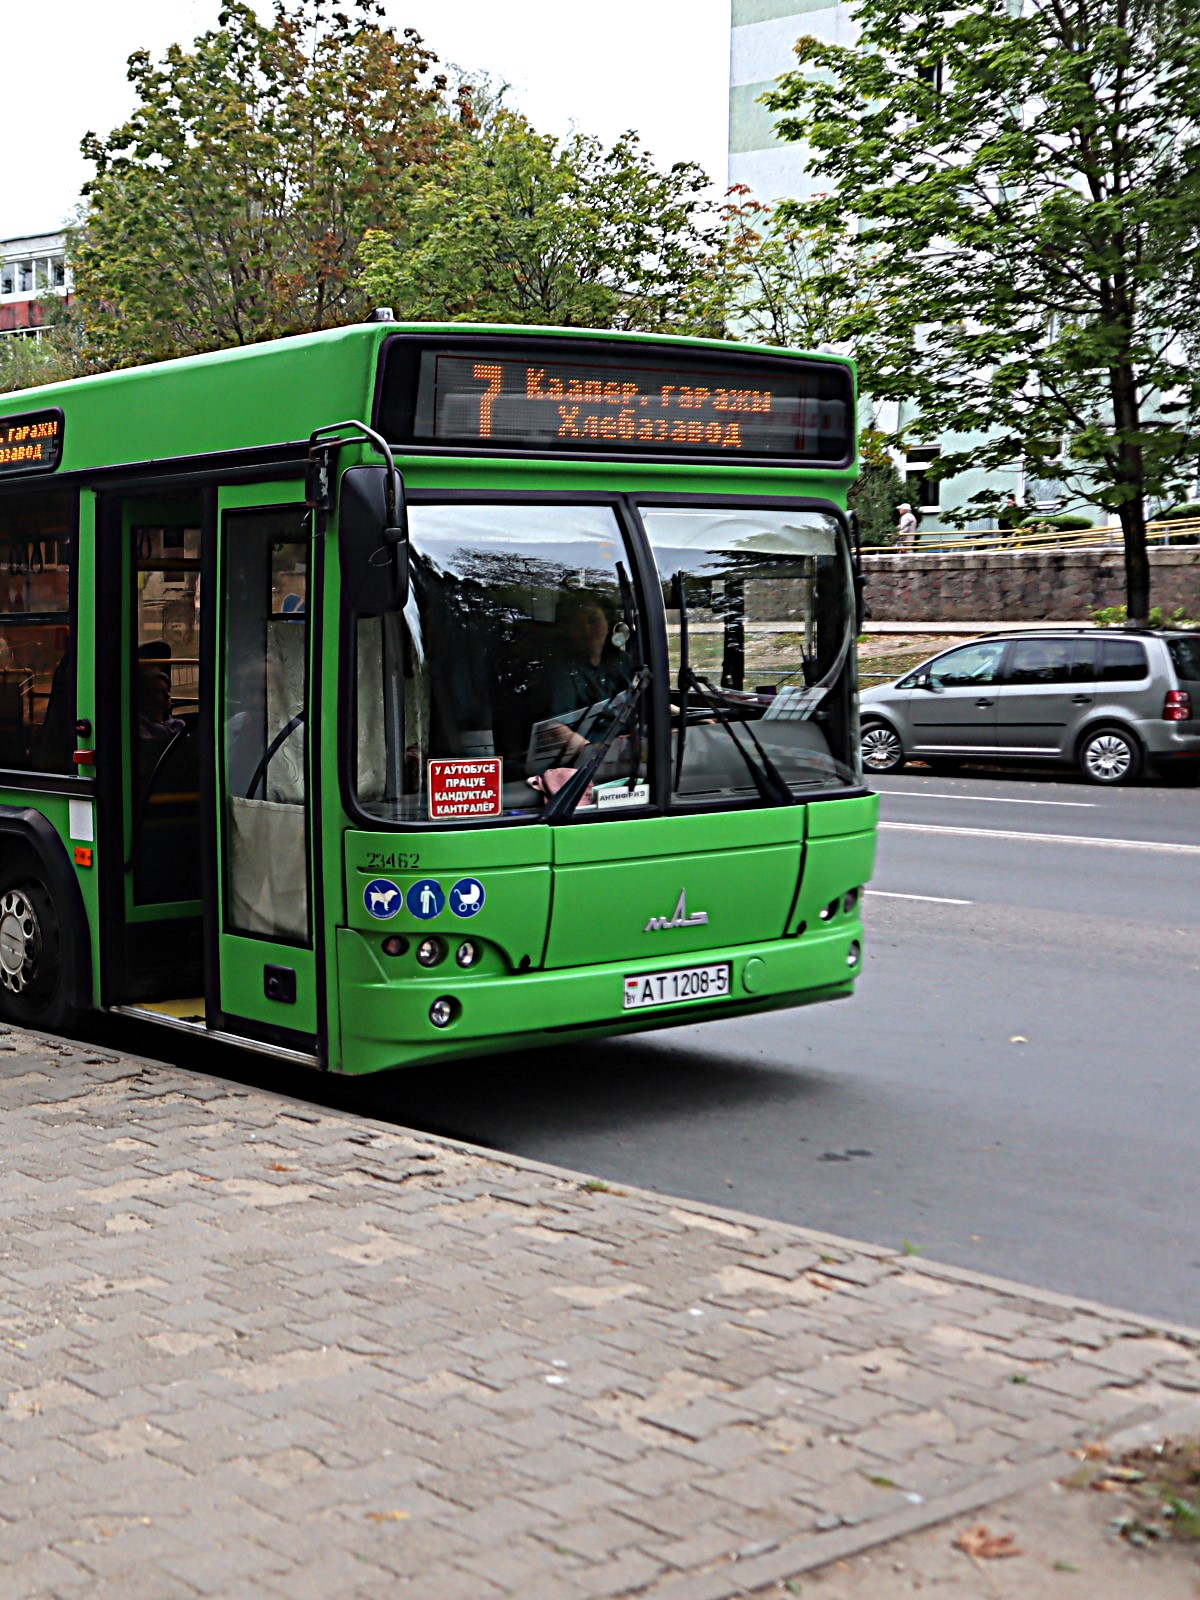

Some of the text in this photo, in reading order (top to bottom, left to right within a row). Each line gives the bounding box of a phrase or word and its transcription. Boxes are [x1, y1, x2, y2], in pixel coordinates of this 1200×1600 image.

[526, 367, 772, 412] Каапер. гаражы
[473, 364, 502, 438] 7
[8, 421, 57, 442] гаражы
[558, 405, 742, 448] Хлебазавод
[435, 764, 496, 775] У АЎТОБУСЕ
[445, 777, 486, 788] ПРАЦУЕ
[435, 789, 496, 802] КАНДУКТАР-
[437, 801, 495, 815] КАНТРАЛЁР
[366, 853, 420, 869] 23462
[673, 968, 727, 998] 1208-5
